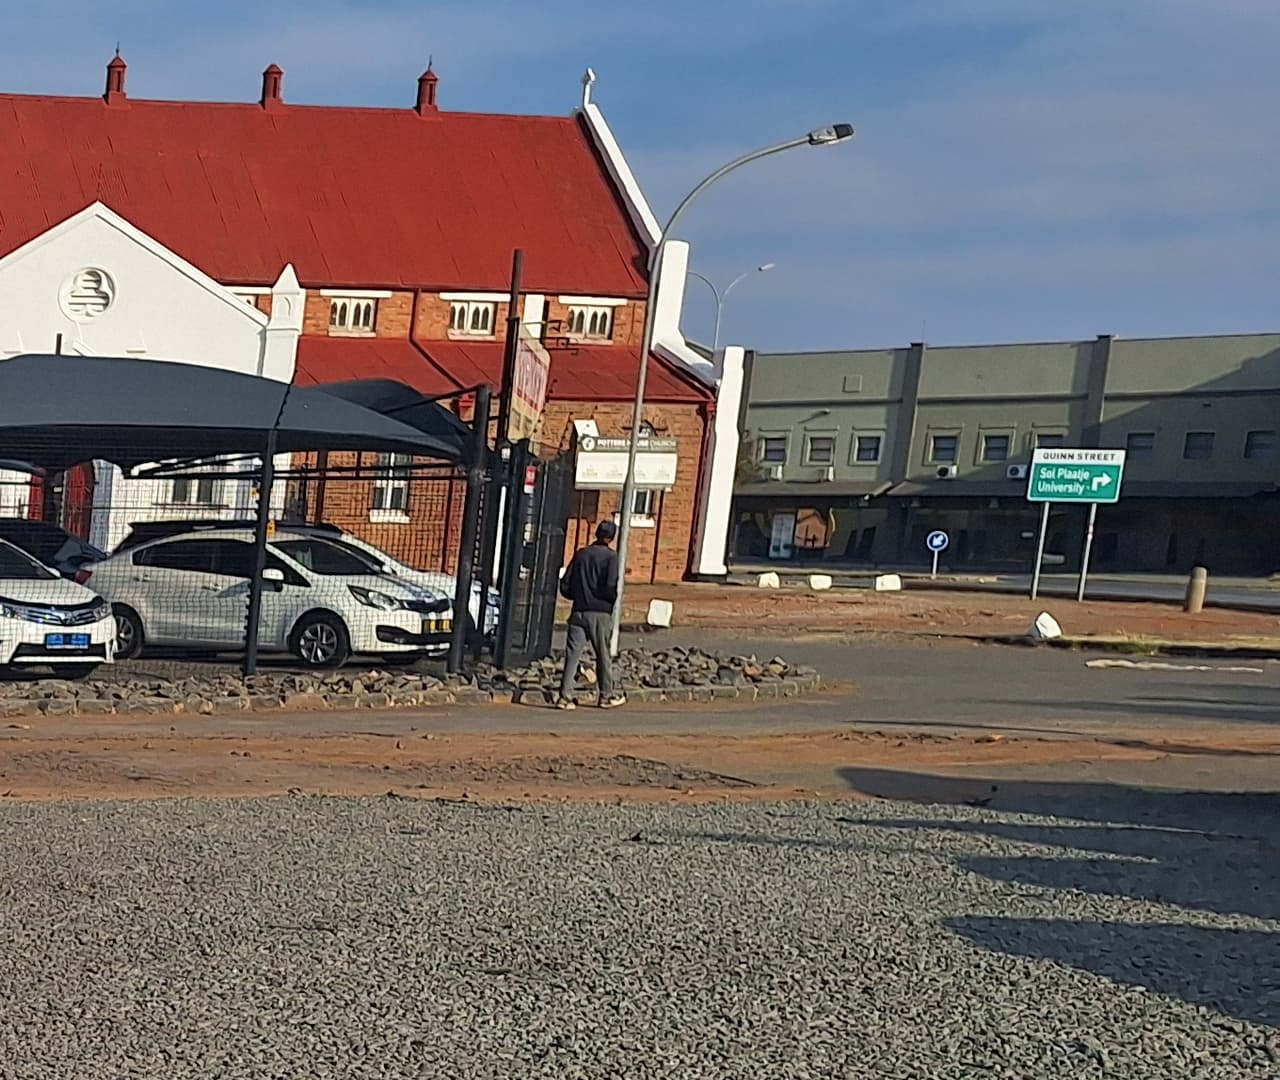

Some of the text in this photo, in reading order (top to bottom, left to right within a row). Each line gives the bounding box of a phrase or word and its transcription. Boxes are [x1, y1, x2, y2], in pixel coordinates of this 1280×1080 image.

[1043, 452, 1074, 460] QUINN
[1040, 467, 1090, 482] Sol Plaatje
[1037, 481, 1085, 495] University
